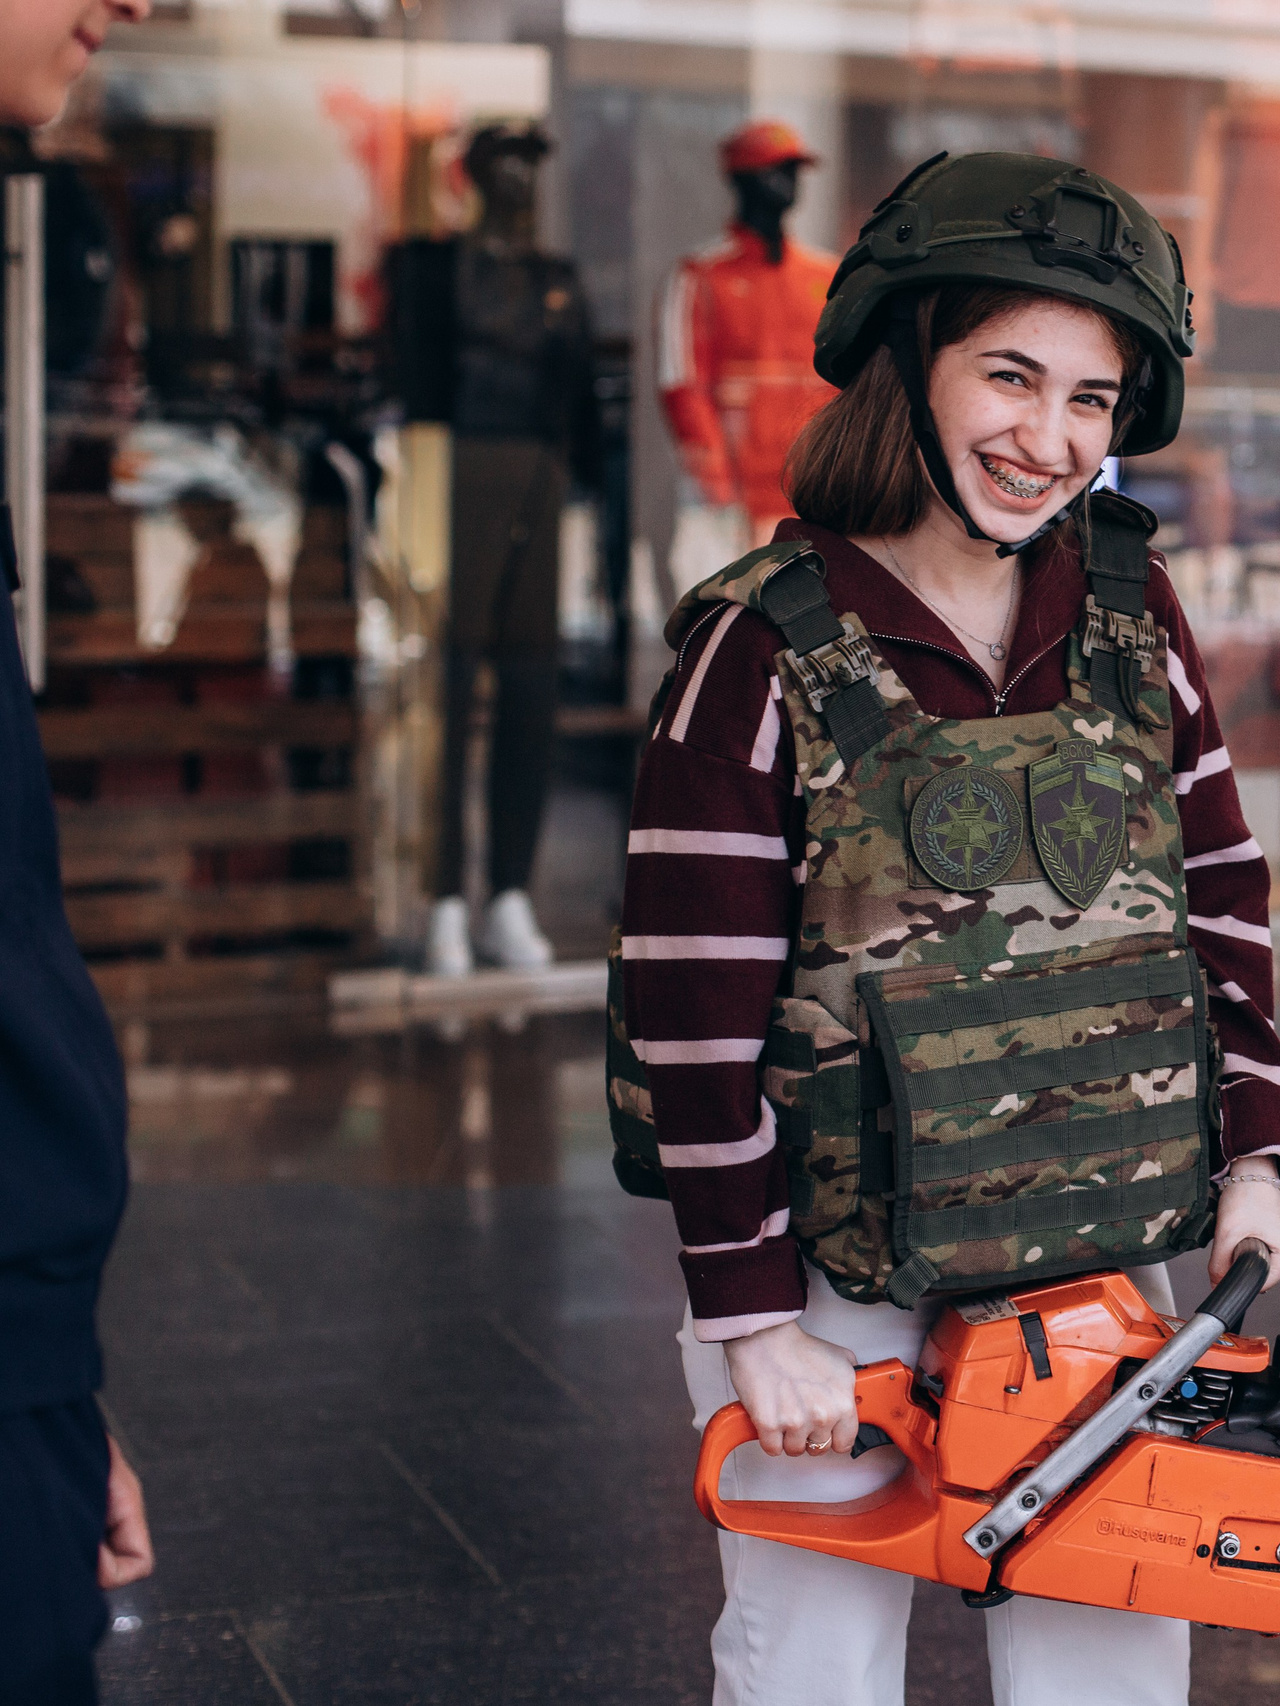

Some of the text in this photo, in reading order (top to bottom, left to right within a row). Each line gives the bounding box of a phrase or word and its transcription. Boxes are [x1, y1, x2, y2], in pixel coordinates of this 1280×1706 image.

[1061, 744, 1092, 760] ВСКС
[917, 845, 965, 886] КОРПУС
[1111, 1520, 1187, 1547] Husqvarna
